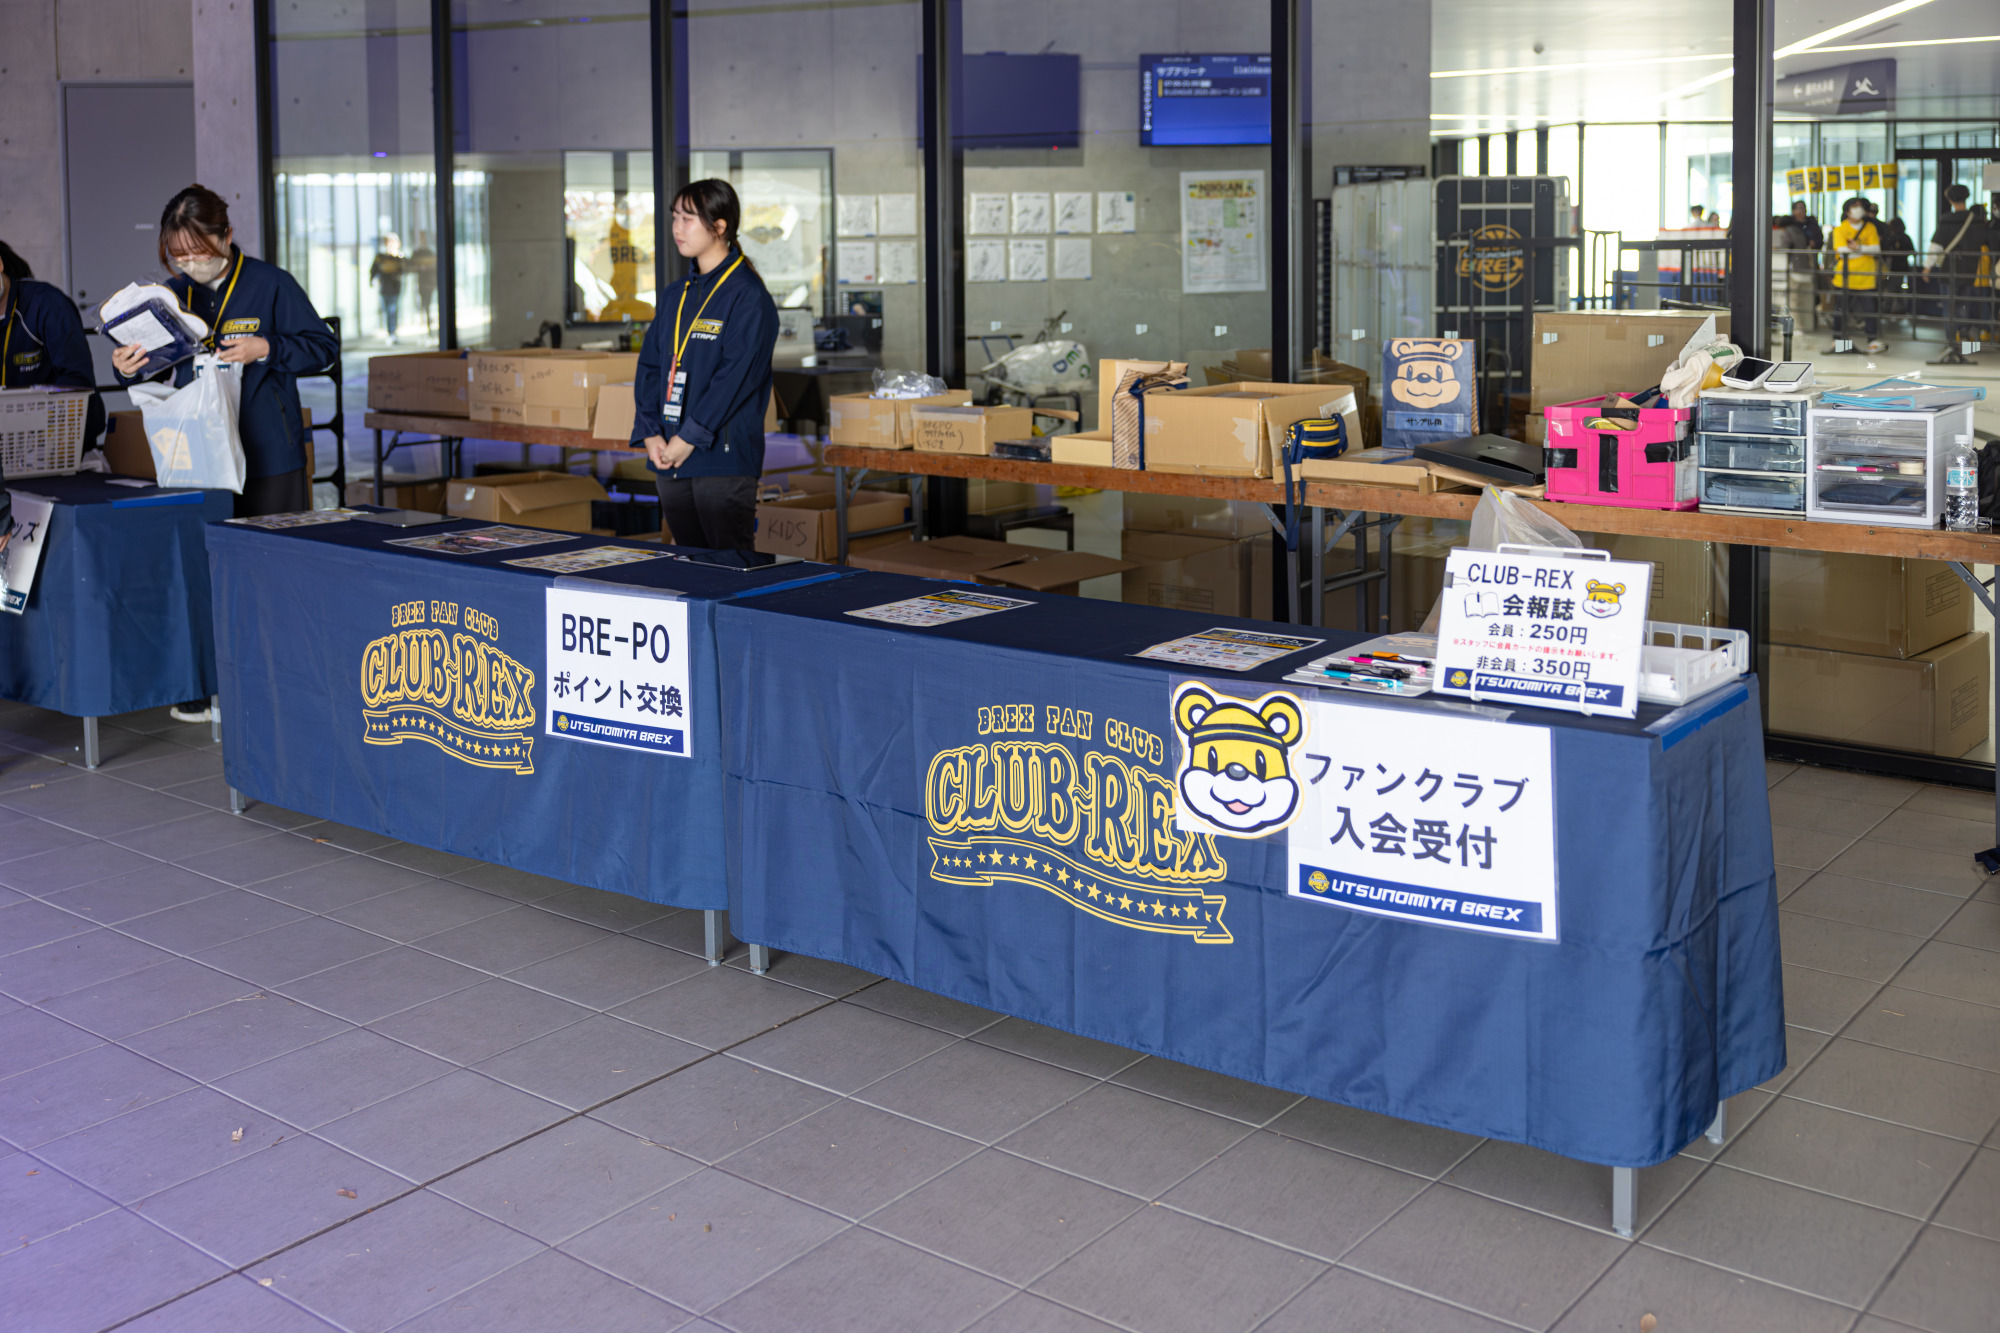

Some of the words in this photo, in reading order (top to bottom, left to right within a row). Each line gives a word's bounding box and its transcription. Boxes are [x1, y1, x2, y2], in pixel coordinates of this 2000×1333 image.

[768, 518, 807, 547] KIDS
[1468, 563, 1575, 590] CLUB-REX
[392, 601, 425, 628] BREX
[431, 600, 459, 625] FAN
[464, 606, 499, 642] CLUB
[1503, 594, 1576, 621] 会報誌
[562, 613, 670, 664] BRE-PO
[553, 671, 683, 717] ポイント交換
[570, 719, 638, 740] UTSUNOMIYA
[639, 731, 674, 745] BREX
[978, 704, 1035, 734] BREX
[1046, 706, 1093, 740] FAN
[1105, 718, 1163, 765] CLUB
[1305, 752, 1530, 813] ファンクラブ
[1329, 805, 1498, 870] 入会受付
[1331, 878, 1458, 913] UTSUNOMIYA
[1460, 901, 1524, 923] BREX
